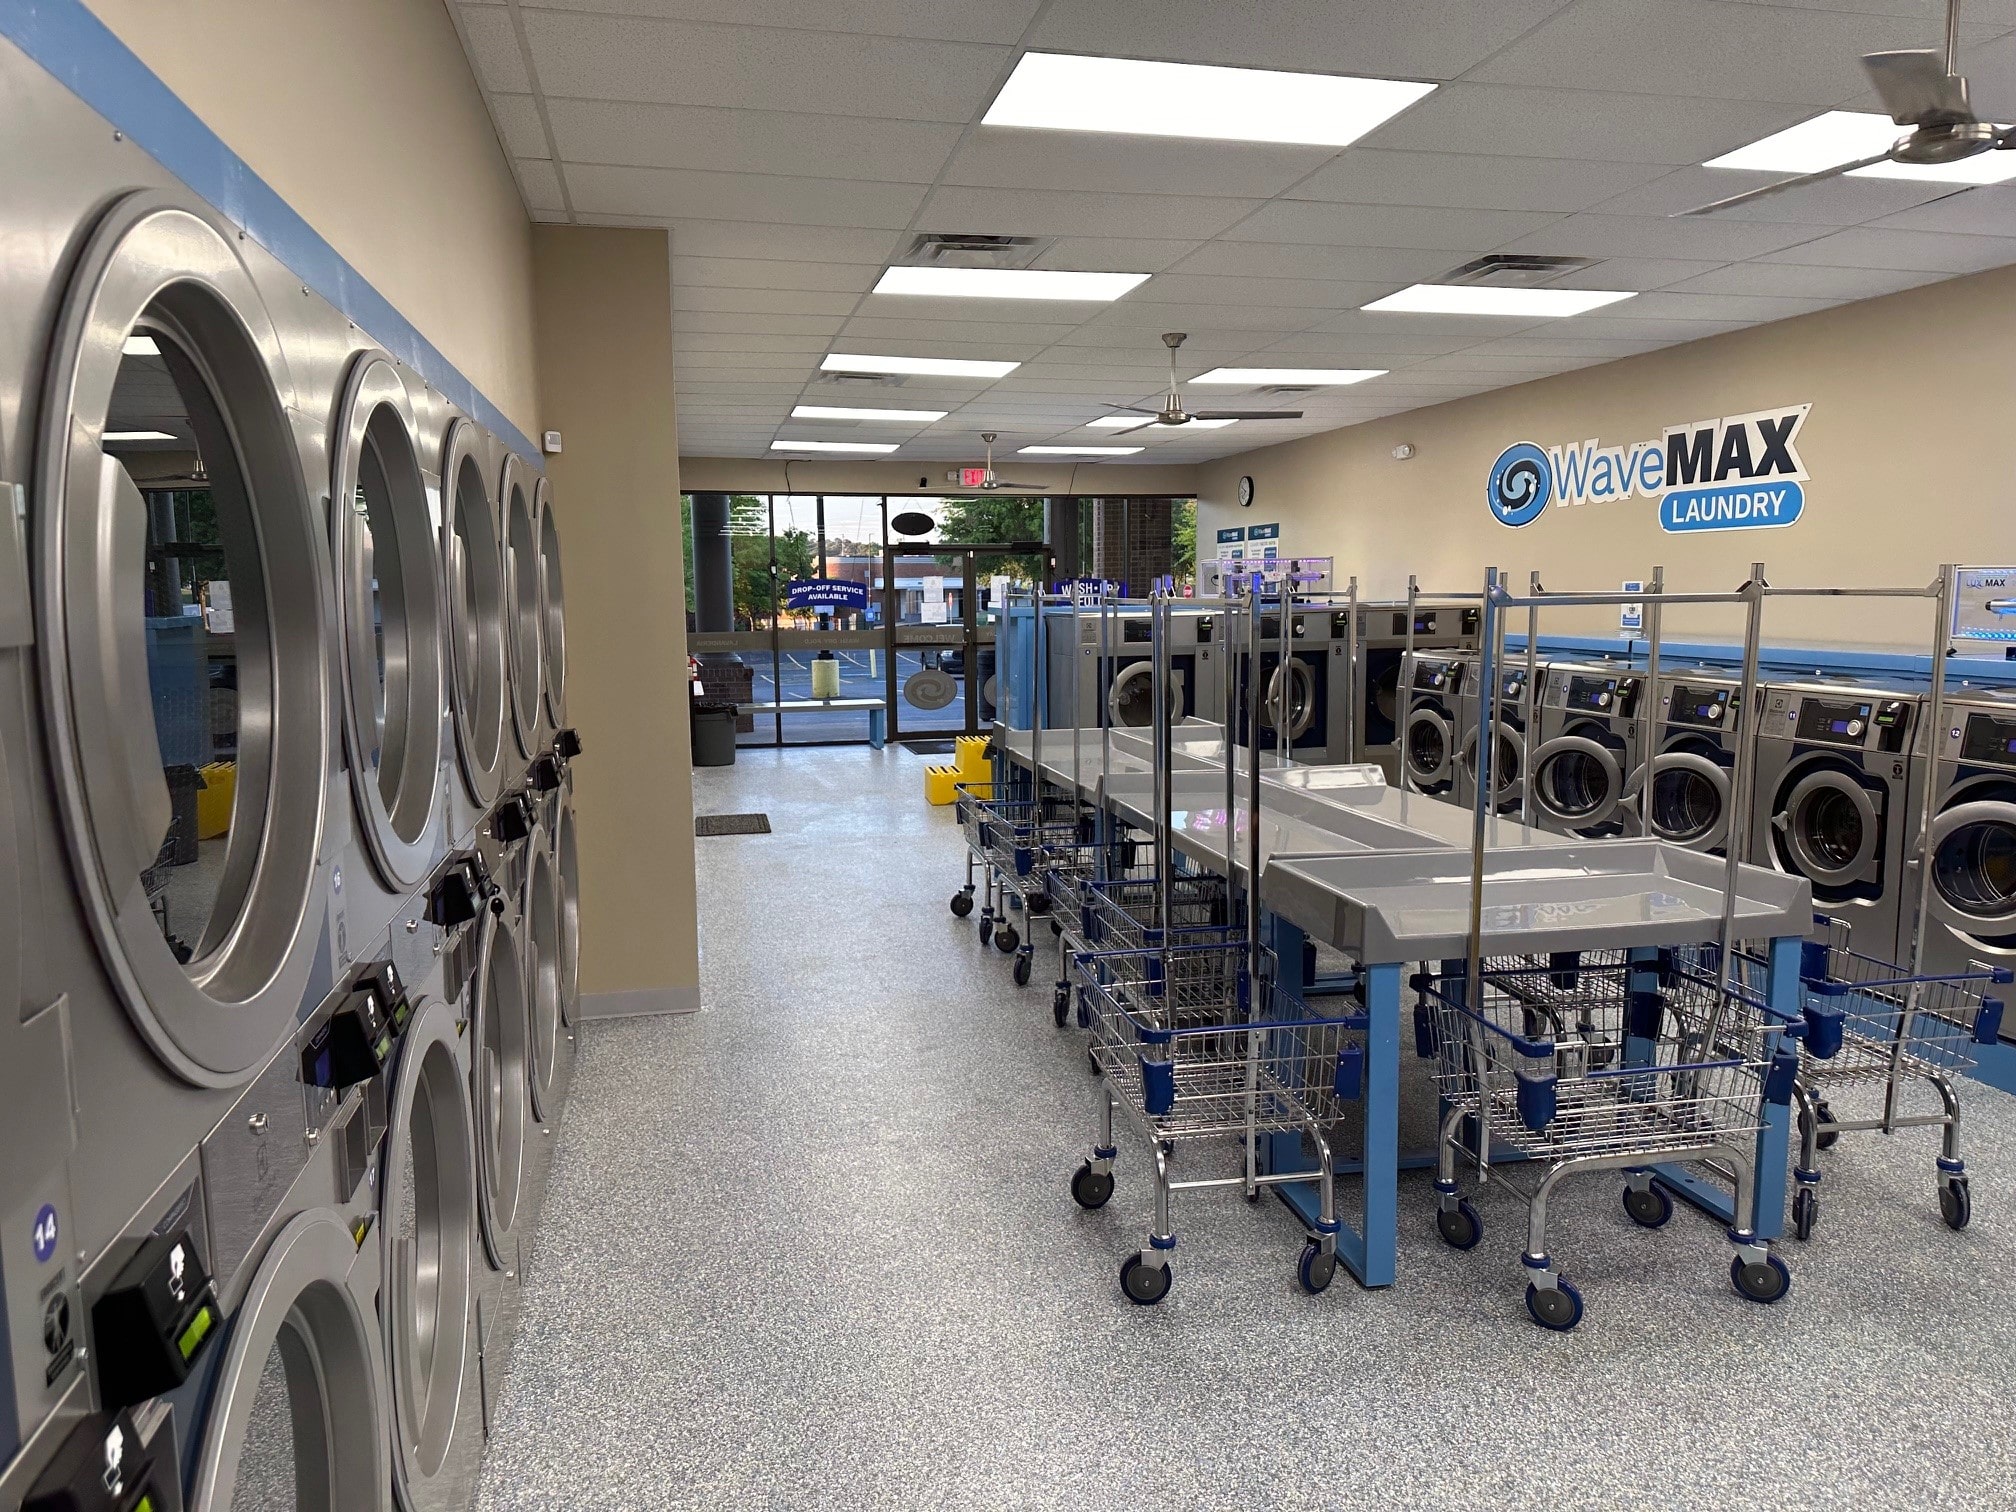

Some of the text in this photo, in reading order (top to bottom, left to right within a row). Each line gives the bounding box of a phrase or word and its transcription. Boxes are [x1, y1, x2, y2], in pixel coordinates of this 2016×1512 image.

[1553, 414, 1799, 500] WaveMAX
[1672, 490, 1787, 523] LAUNDRY
[791, 585, 864, 595] DROP-OFF SERVICE
[1985, 579, 2006, 587] MAX
[35, 1213, 57, 1251] 14
